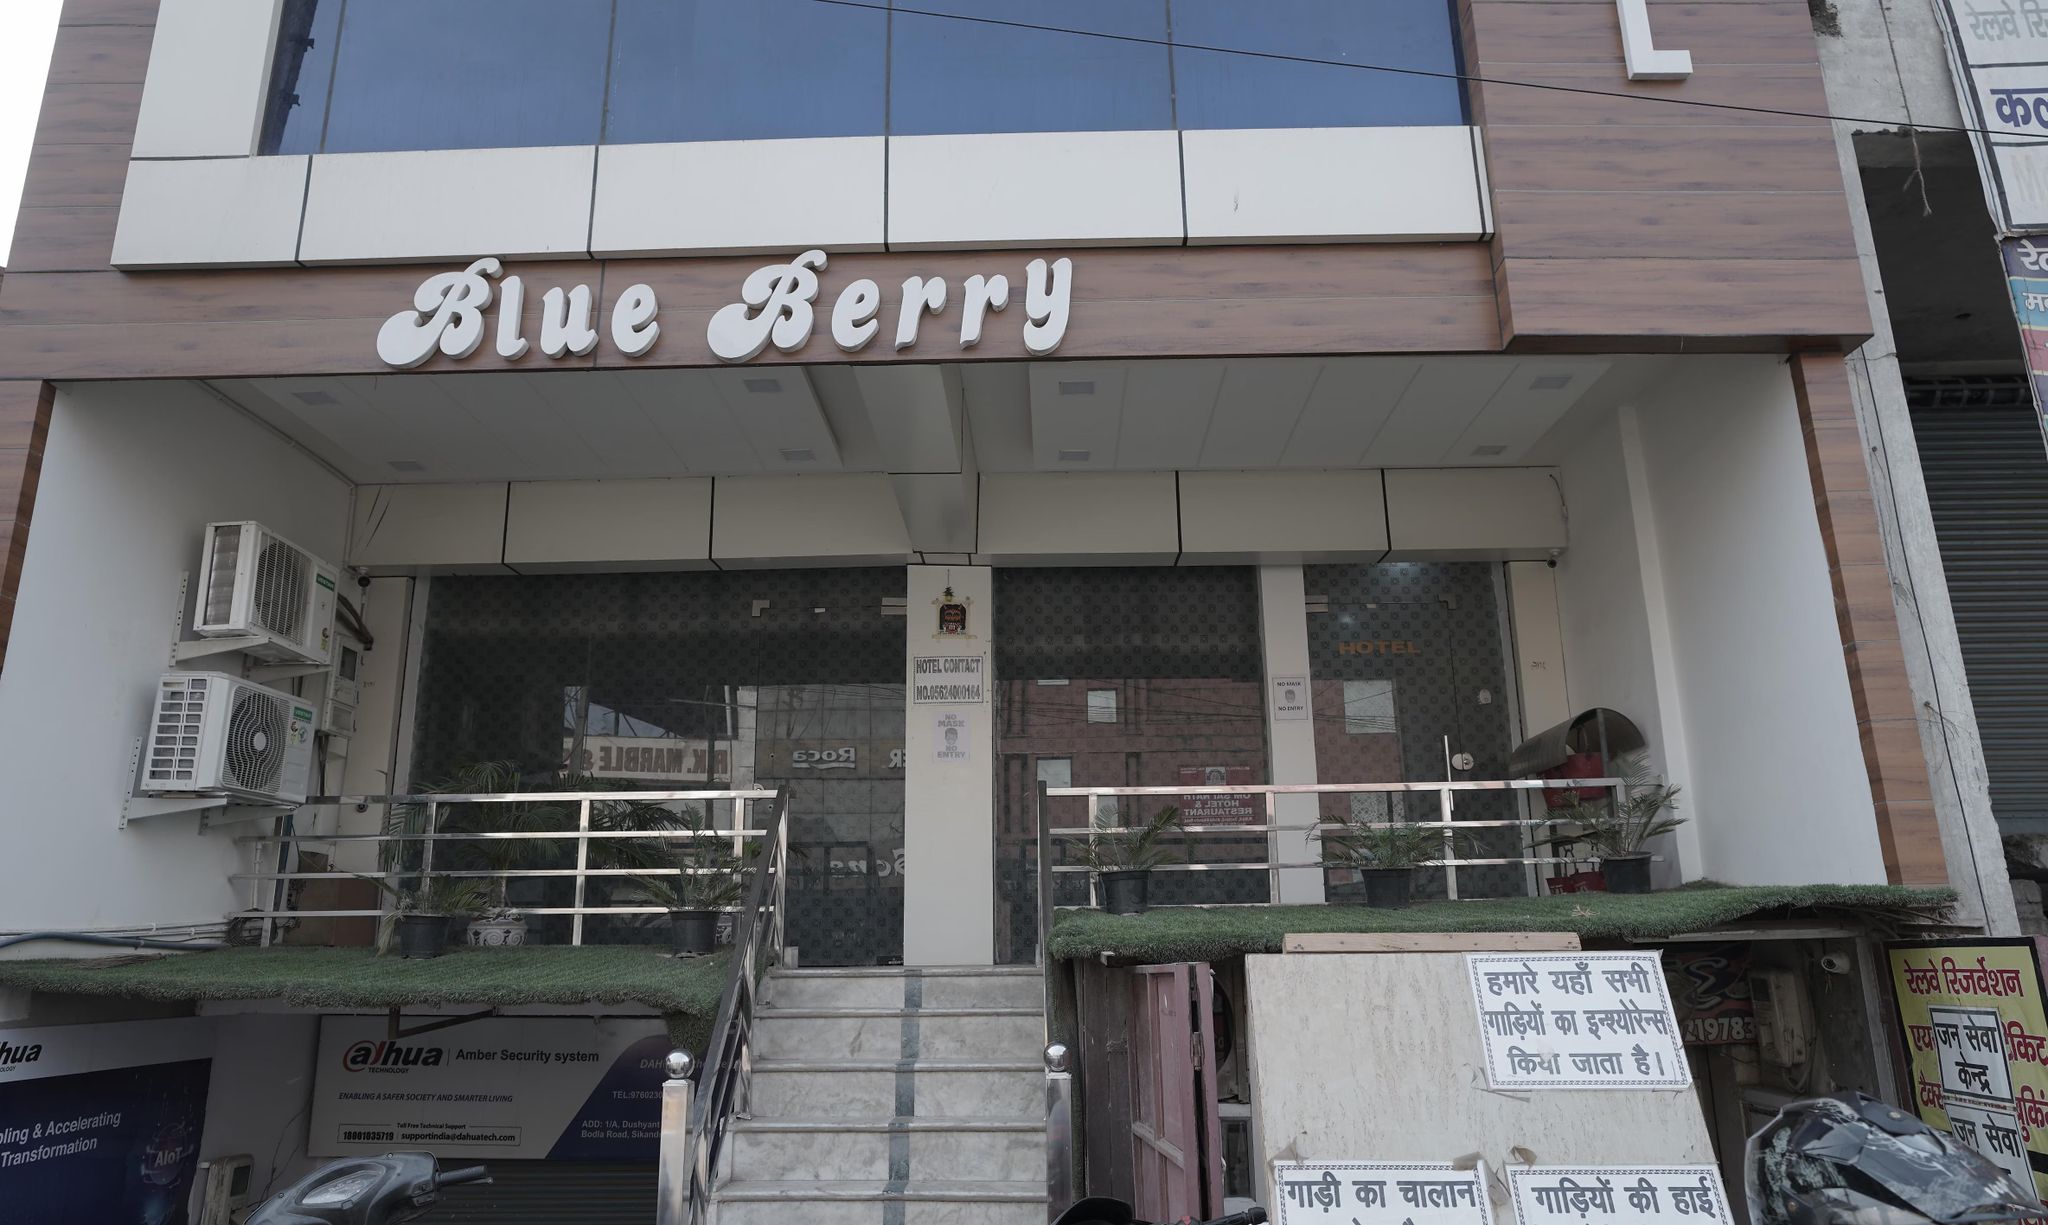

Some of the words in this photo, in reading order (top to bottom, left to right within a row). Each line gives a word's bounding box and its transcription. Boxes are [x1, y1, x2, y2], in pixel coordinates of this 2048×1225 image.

[376, 257, 660, 369] Blue
[706, 249, 1073, 364] Berry
[1337, 640, 1421, 657] HOTEL
[916, 659, 942, 674] HOTEL
[944, 658, 980, 674] CONTACT
[937, 720, 966, 728] MASK
[944, 713, 958, 721] NO
[937, 751, 966, 759] ENTRY
[1484, 962, 1540, 996] हमारे
[1548, 961, 1593, 996] यहाँ
[1602, 961, 1651, 993] सभी
[1904, 957, 1943, 995] रेलवे
[1941, 956, 2024, 997] रिजर्वेशन
[1551, 1010, 1579, 1035] का
[1935, 1022, 1961, 1050] जन
[1963, 1015, 1998, 1053] सेवा
[0, 1041, 42, 1065] hua
[455, 1048, 497, 1062] Amber
[500, 1049, 551, 1064] Security
[554, 1051, 600, 1064] system
[1569, 1053, 1623, 1075] जाता
[367, 1066, 410, 1074] TECHNOLOGY
[1955, 1052, 1992, 1094] केन्द्र
[338, 1092, 376, 1101] ENABLING
[382, 1093, 406, 1101] SAFER
[406, 1093, 436, 1102] SOCIETY
[437, 1094, 454, 1102] AND
[454, 1094, 488, 1102] SMARTER
[488, 1095, 513, 1103] LIVING
[33, 1123, 42, 1139] &
[45, 1111, 122, 1137] Accelerating
[631, 1130, 661, 1139] Sikand
[1951, 1117, 1979, 1149] जन
[1982, 1113, 2021, 1158] सेवा
[1, 1137, 98, 1167] Transformation
[1284, 1171, 1341, 1213] गाड़ी
[1352, 1179, 1386, 1208] का
[1399, 1179, 1477, 1208] चालान
[1623, 1176, 1662, 1214] की
[1668, 1176, 1717, 1218] हाई
